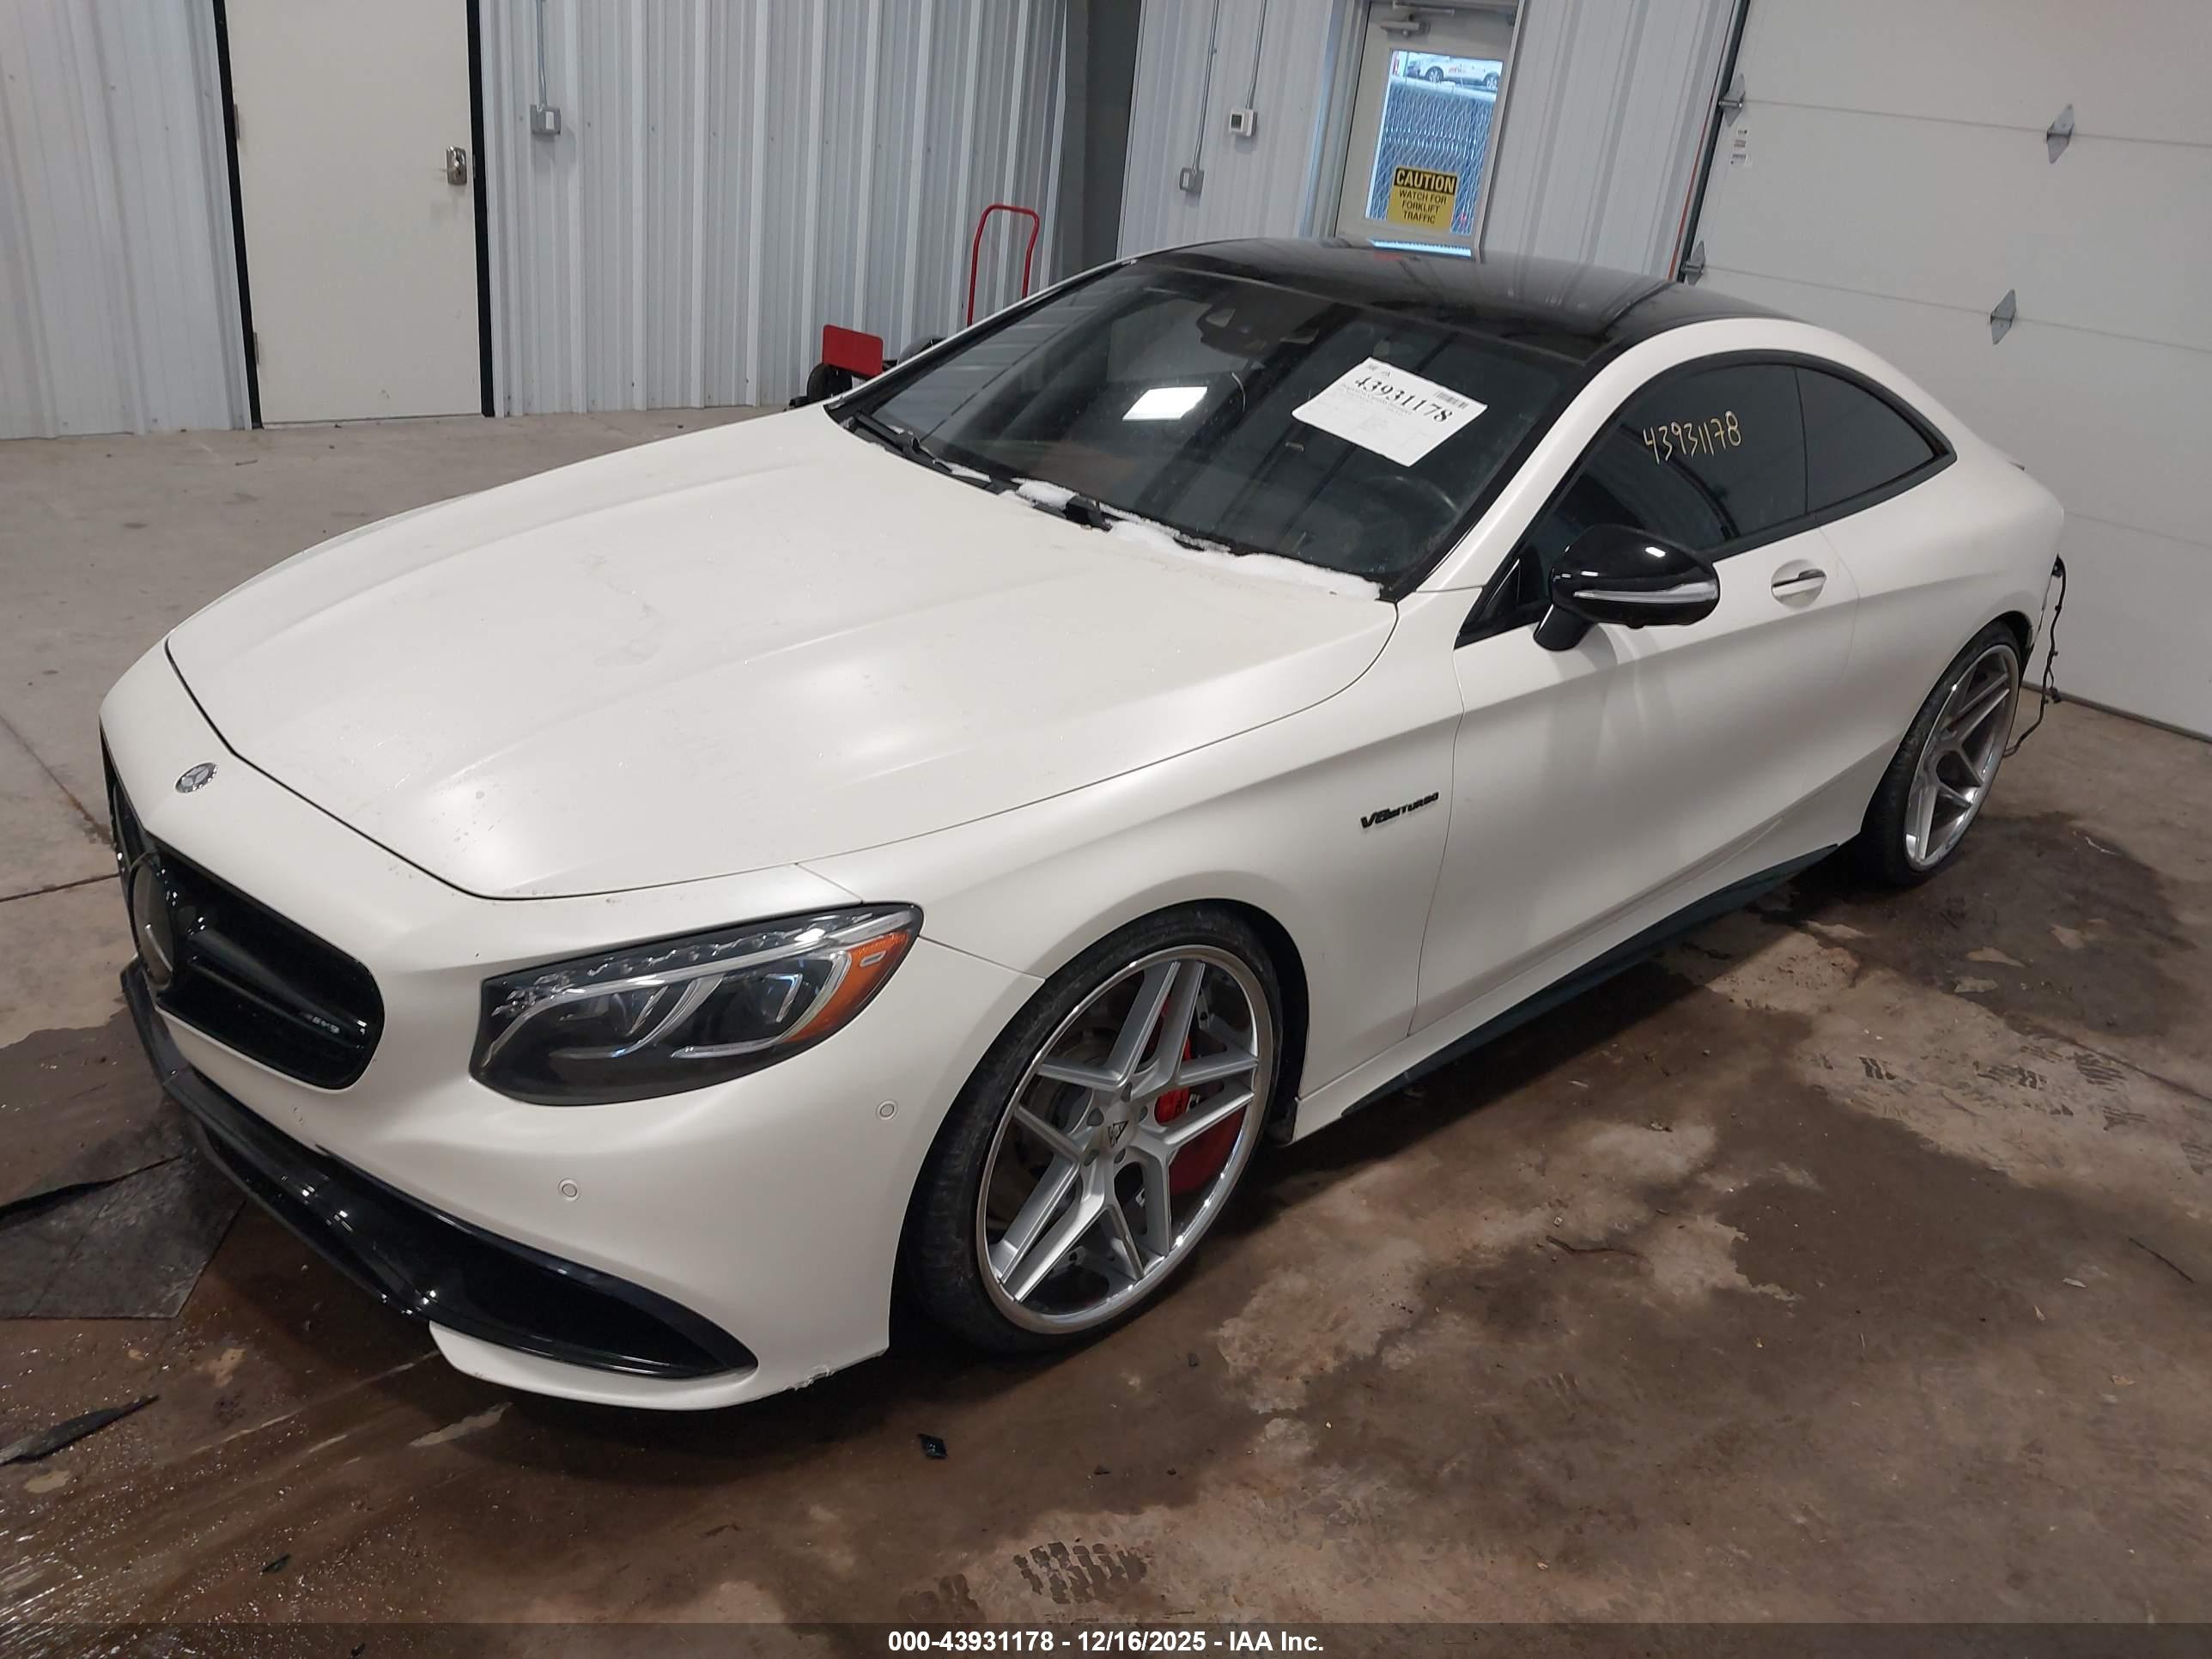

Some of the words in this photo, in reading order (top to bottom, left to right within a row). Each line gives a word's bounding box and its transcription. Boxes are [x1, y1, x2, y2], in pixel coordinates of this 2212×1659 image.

[1396, 169, 1455, 192] CAUTION
[1399, 188, 1429, 201] WATCH
[1430, 192, 1448, 205] FOR
[1401, 200, 1441, 215] FORKLIFT
[1403, 210, 1436, 224] TRAFFIC
[1355, 376, 1453, 422] 43931178
[1643, 410, 1741, 465] 43931178
